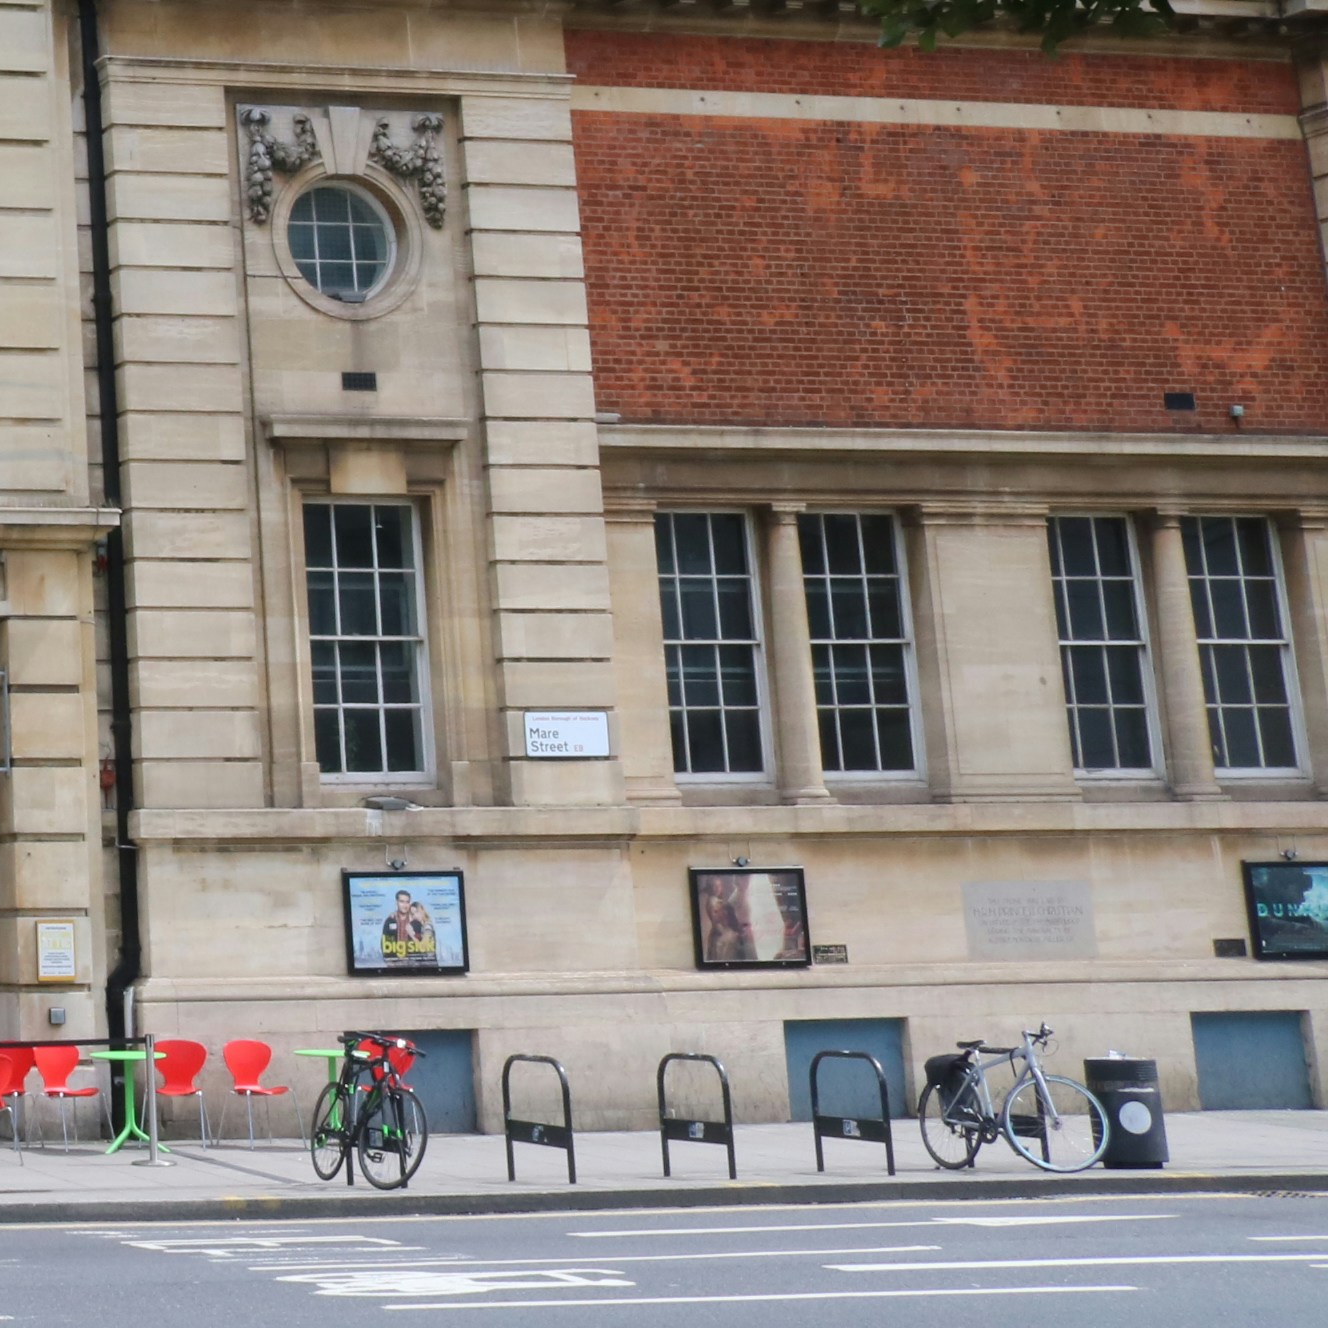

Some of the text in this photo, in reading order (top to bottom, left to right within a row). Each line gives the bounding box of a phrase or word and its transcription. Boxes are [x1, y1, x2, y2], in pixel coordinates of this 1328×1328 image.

[529, 727, 559, 739] Mare
[530, 740, 569, 753] Street
[382, 934, 435, 958] big sick
